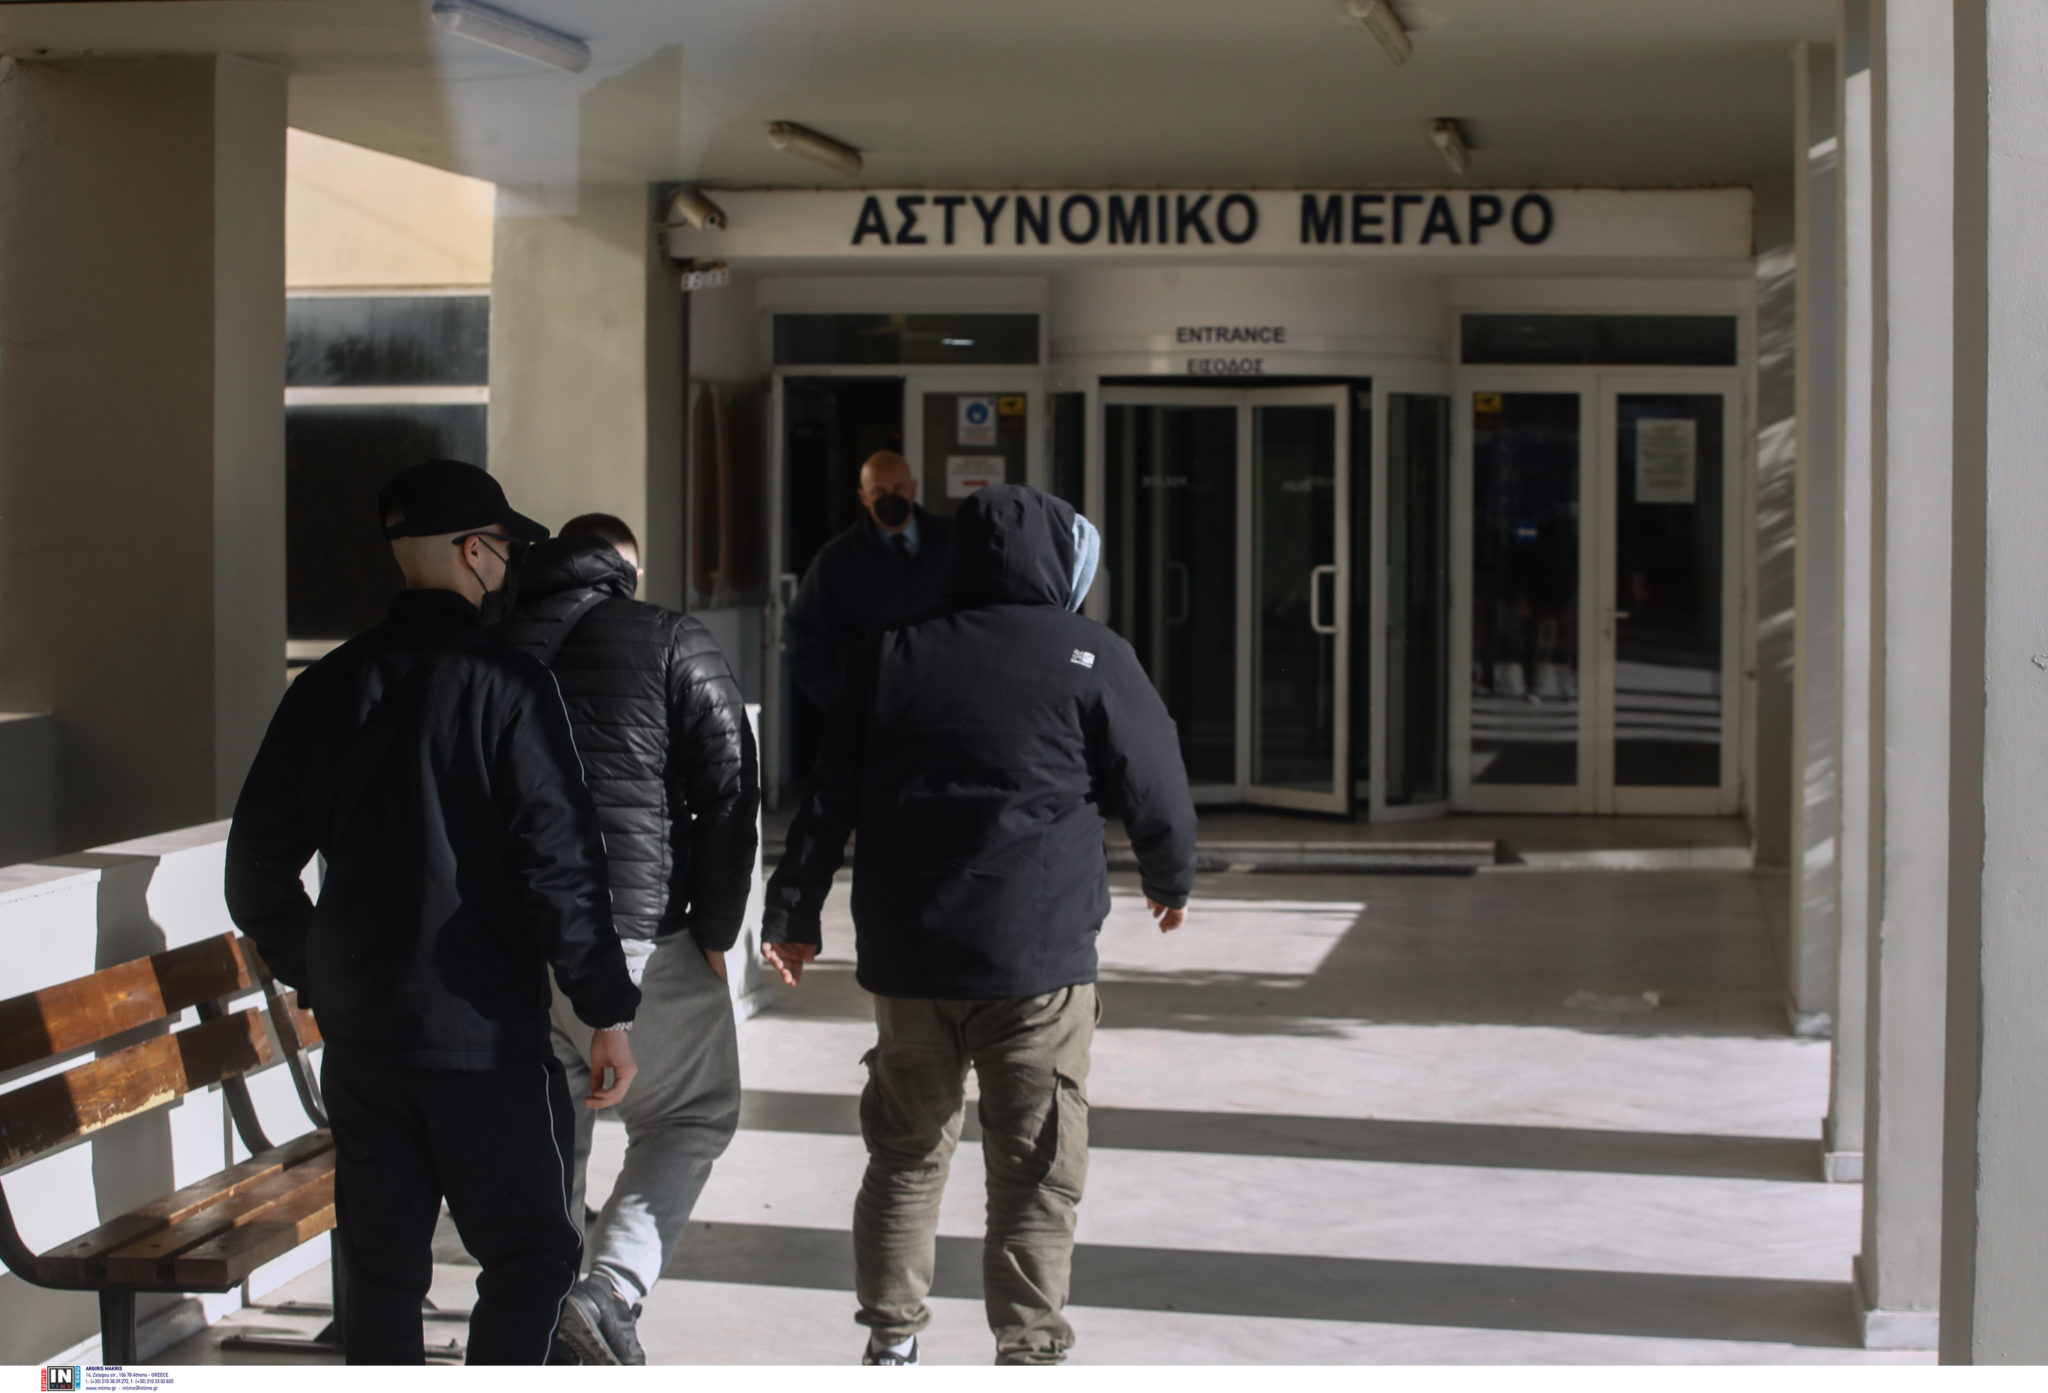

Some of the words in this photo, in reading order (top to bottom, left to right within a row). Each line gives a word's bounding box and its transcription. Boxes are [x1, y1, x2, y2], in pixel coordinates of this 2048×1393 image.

[851, 193, 1258, 246] ΑΣΤΥΝΟΜΙΚΟ
[1301, 193, 1555, 245] ΜΕΓΑΡΟ
[1177, 325, 1287, 344] ENTRANCE
[1187, 358, 1265, 376] ΕΙΣΟΔΟΣ
